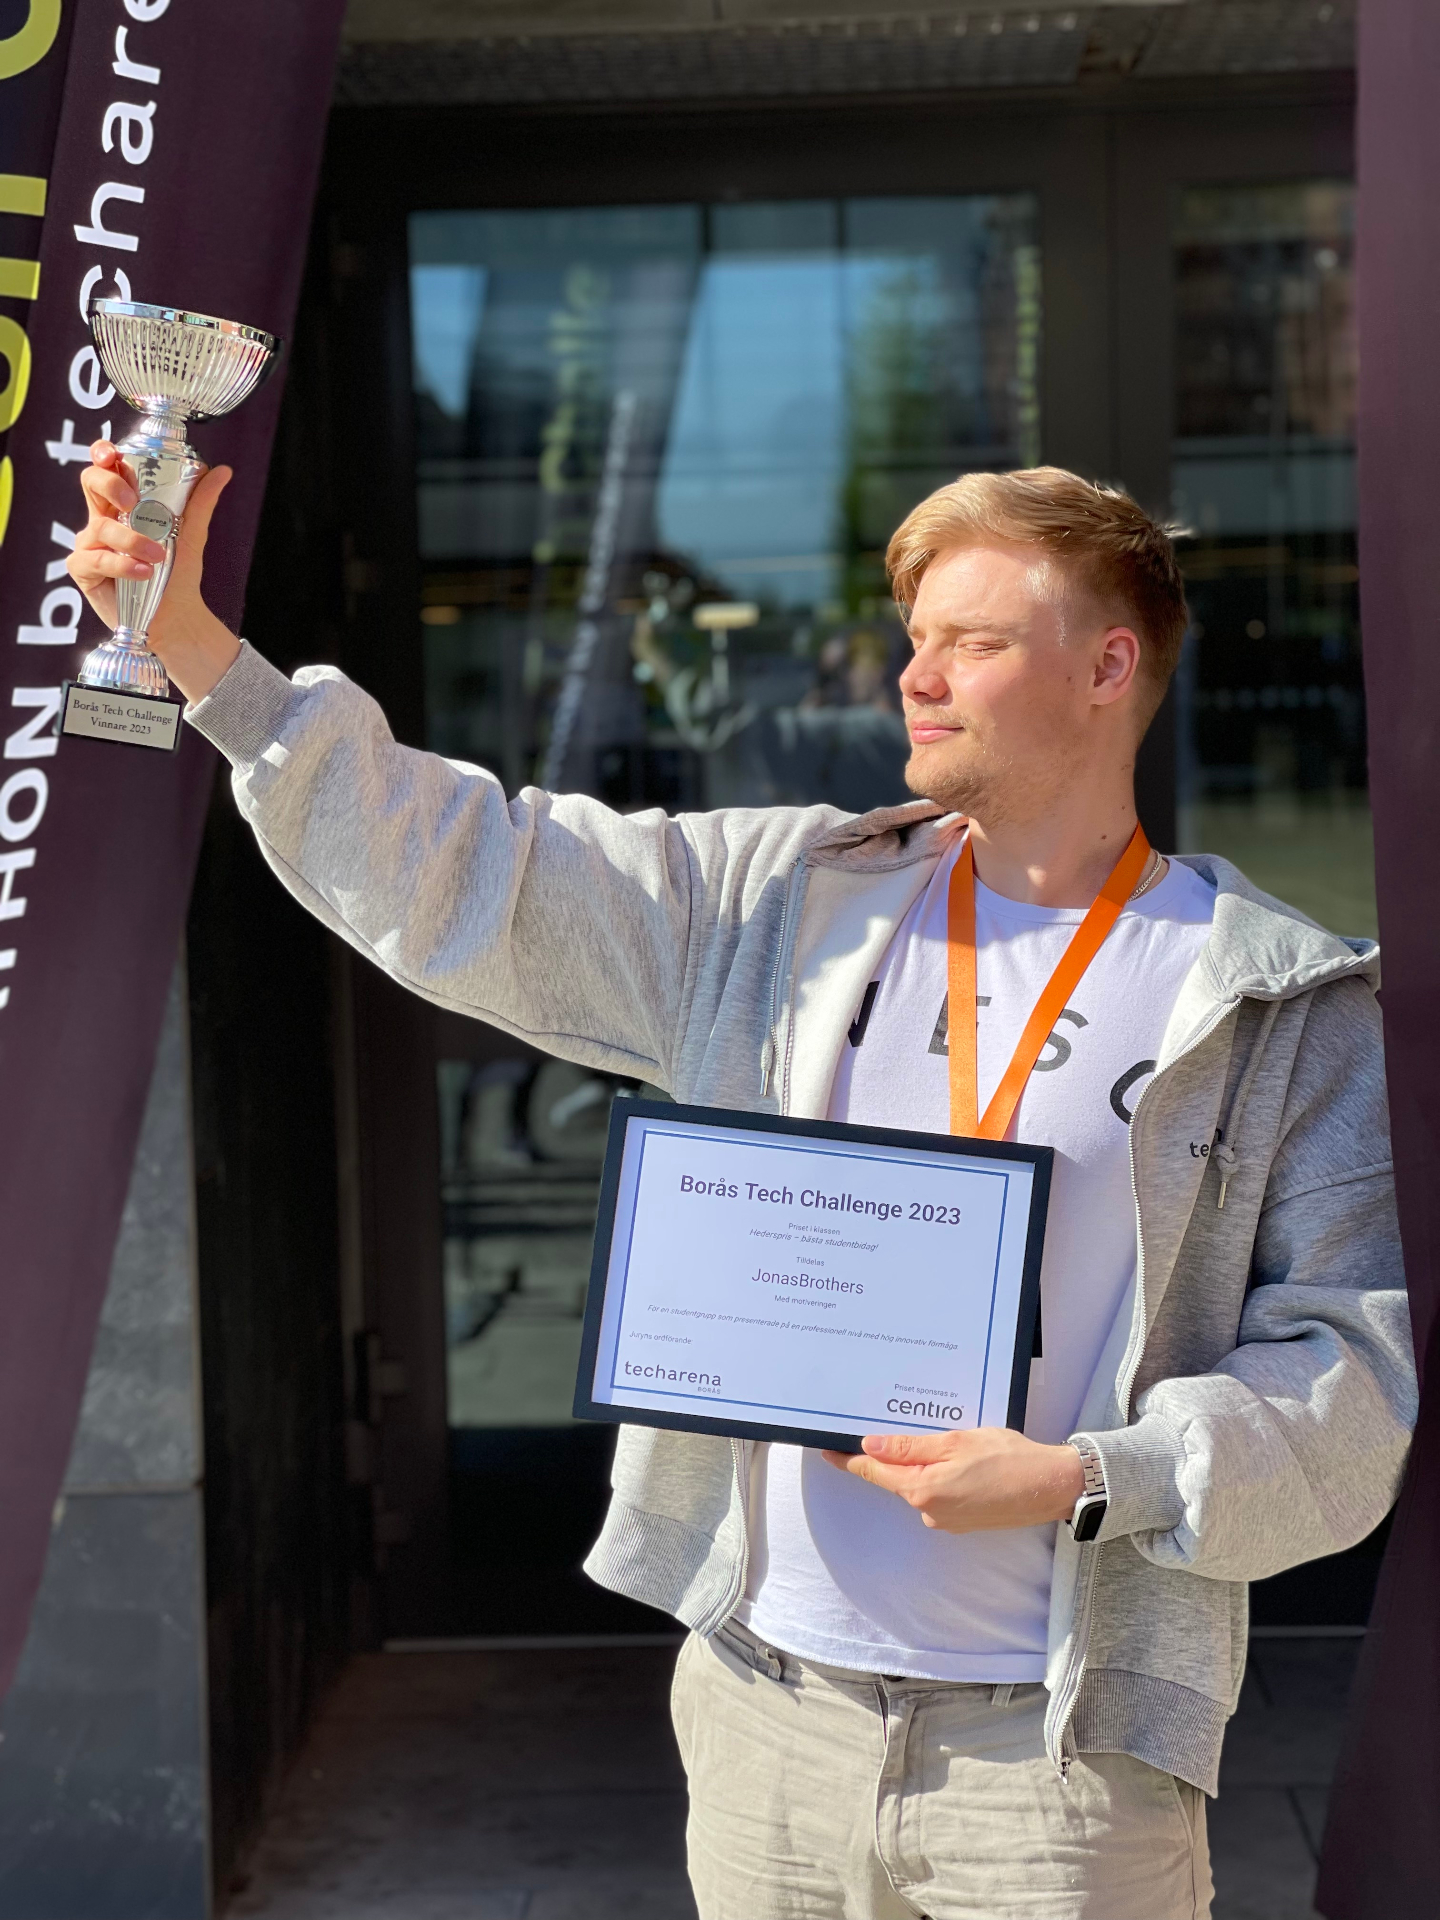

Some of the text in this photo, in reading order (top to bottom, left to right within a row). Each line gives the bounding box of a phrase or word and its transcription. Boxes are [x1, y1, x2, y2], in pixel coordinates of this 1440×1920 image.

[73, 699, 173, 726] Borås Tech Challenge
[91, 716, 151, 735] Vinnare 2023
[680, 1174, 962, 1225] Borås Tech Challenge 2023
[788, 1222, 810, 1232] Priset
[813, 1225, 841, 1236] klassen
[749, 1228, 792, 1242] Hederspris
[800, 1233, 823, 1245] bästa
[824, 1237, 879, 1252] studentbidag!
[796, 1256, 825, 1267] Tilldelas
[751, 1268, 864, 1295] JonasBrothers
[774, 1295, 837, 1309] Med motiveringen
[629, 1330, 653, 1342] Juryns
[647, 1304, 660, 1312] För
[670, 1307, 717, 1320] studentgrupp
[718, 1314, 734, 1322] som
[733, 1315, 780, 1328] presenterade
[780, 1317, 791, 1329] på
[801, 1322, 848, 1337] professionell
[848, 1328, 863, 1338] nivå
[863, 1331, 880, 1340] med
[880, 1332, 895, 1344] hög
[895, 1335, 928, 1347] innovativ
[624, 1360, 722, 1387] techarena
[697, 1386, 721, 1395] BORÅS
[894, 1383, 959, 1398] Priset sponsras av
[886, 1398, 963, 1421] centiro
